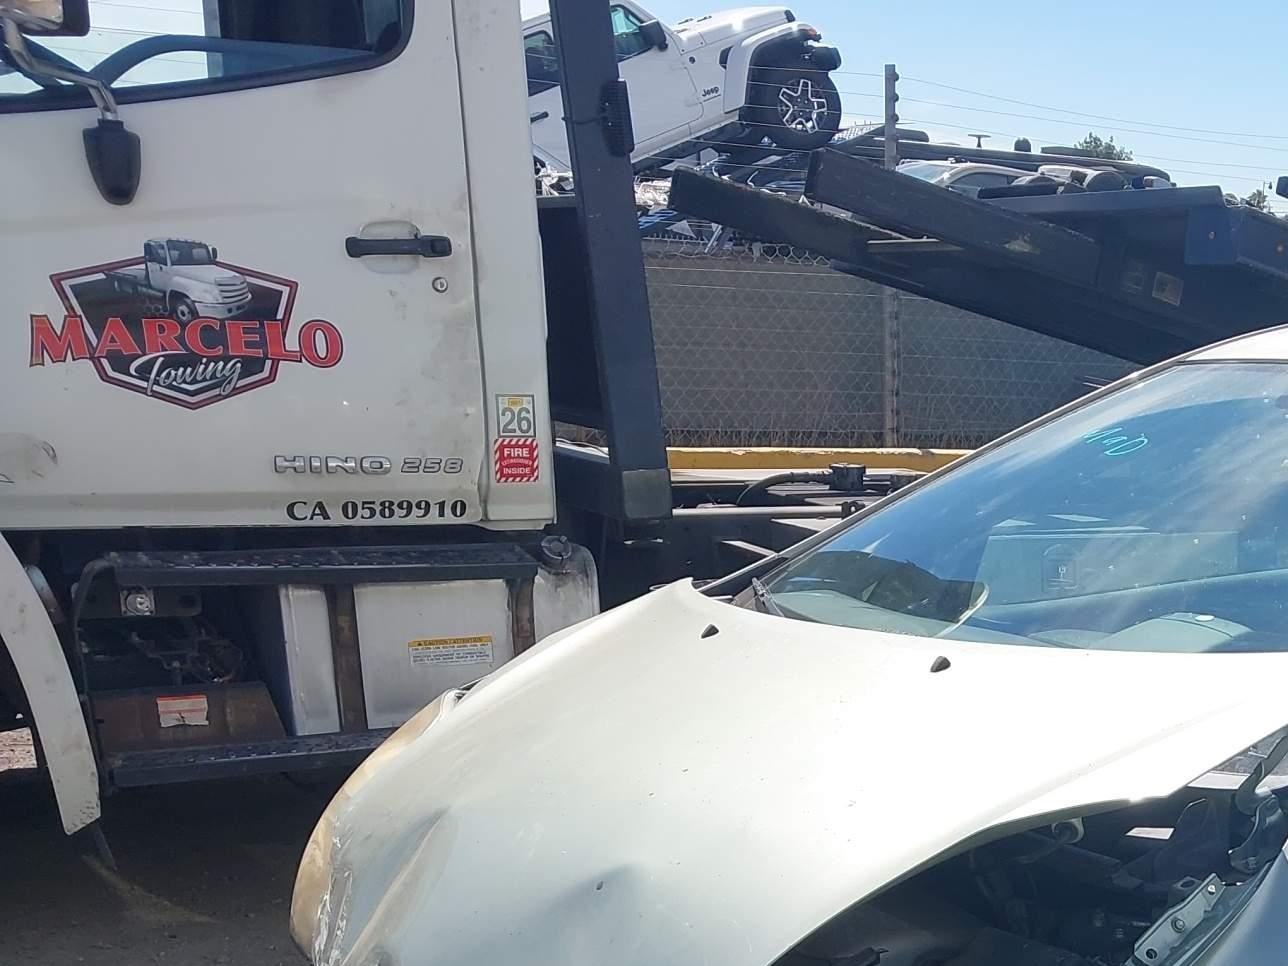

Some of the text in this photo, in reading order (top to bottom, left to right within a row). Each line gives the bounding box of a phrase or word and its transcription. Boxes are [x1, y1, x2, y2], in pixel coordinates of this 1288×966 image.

[29, 313, 344, 368] MARCELO
[129, 351, 243, 396] Towing
[501, 406, 532, 434] 26
[503, 447, 530, 458] FIRE
[274, 455, 464, 475] HINO 258
[503, 467, 531, 475] INSIDE
[286, 499, 467, 521] CA 0589910
